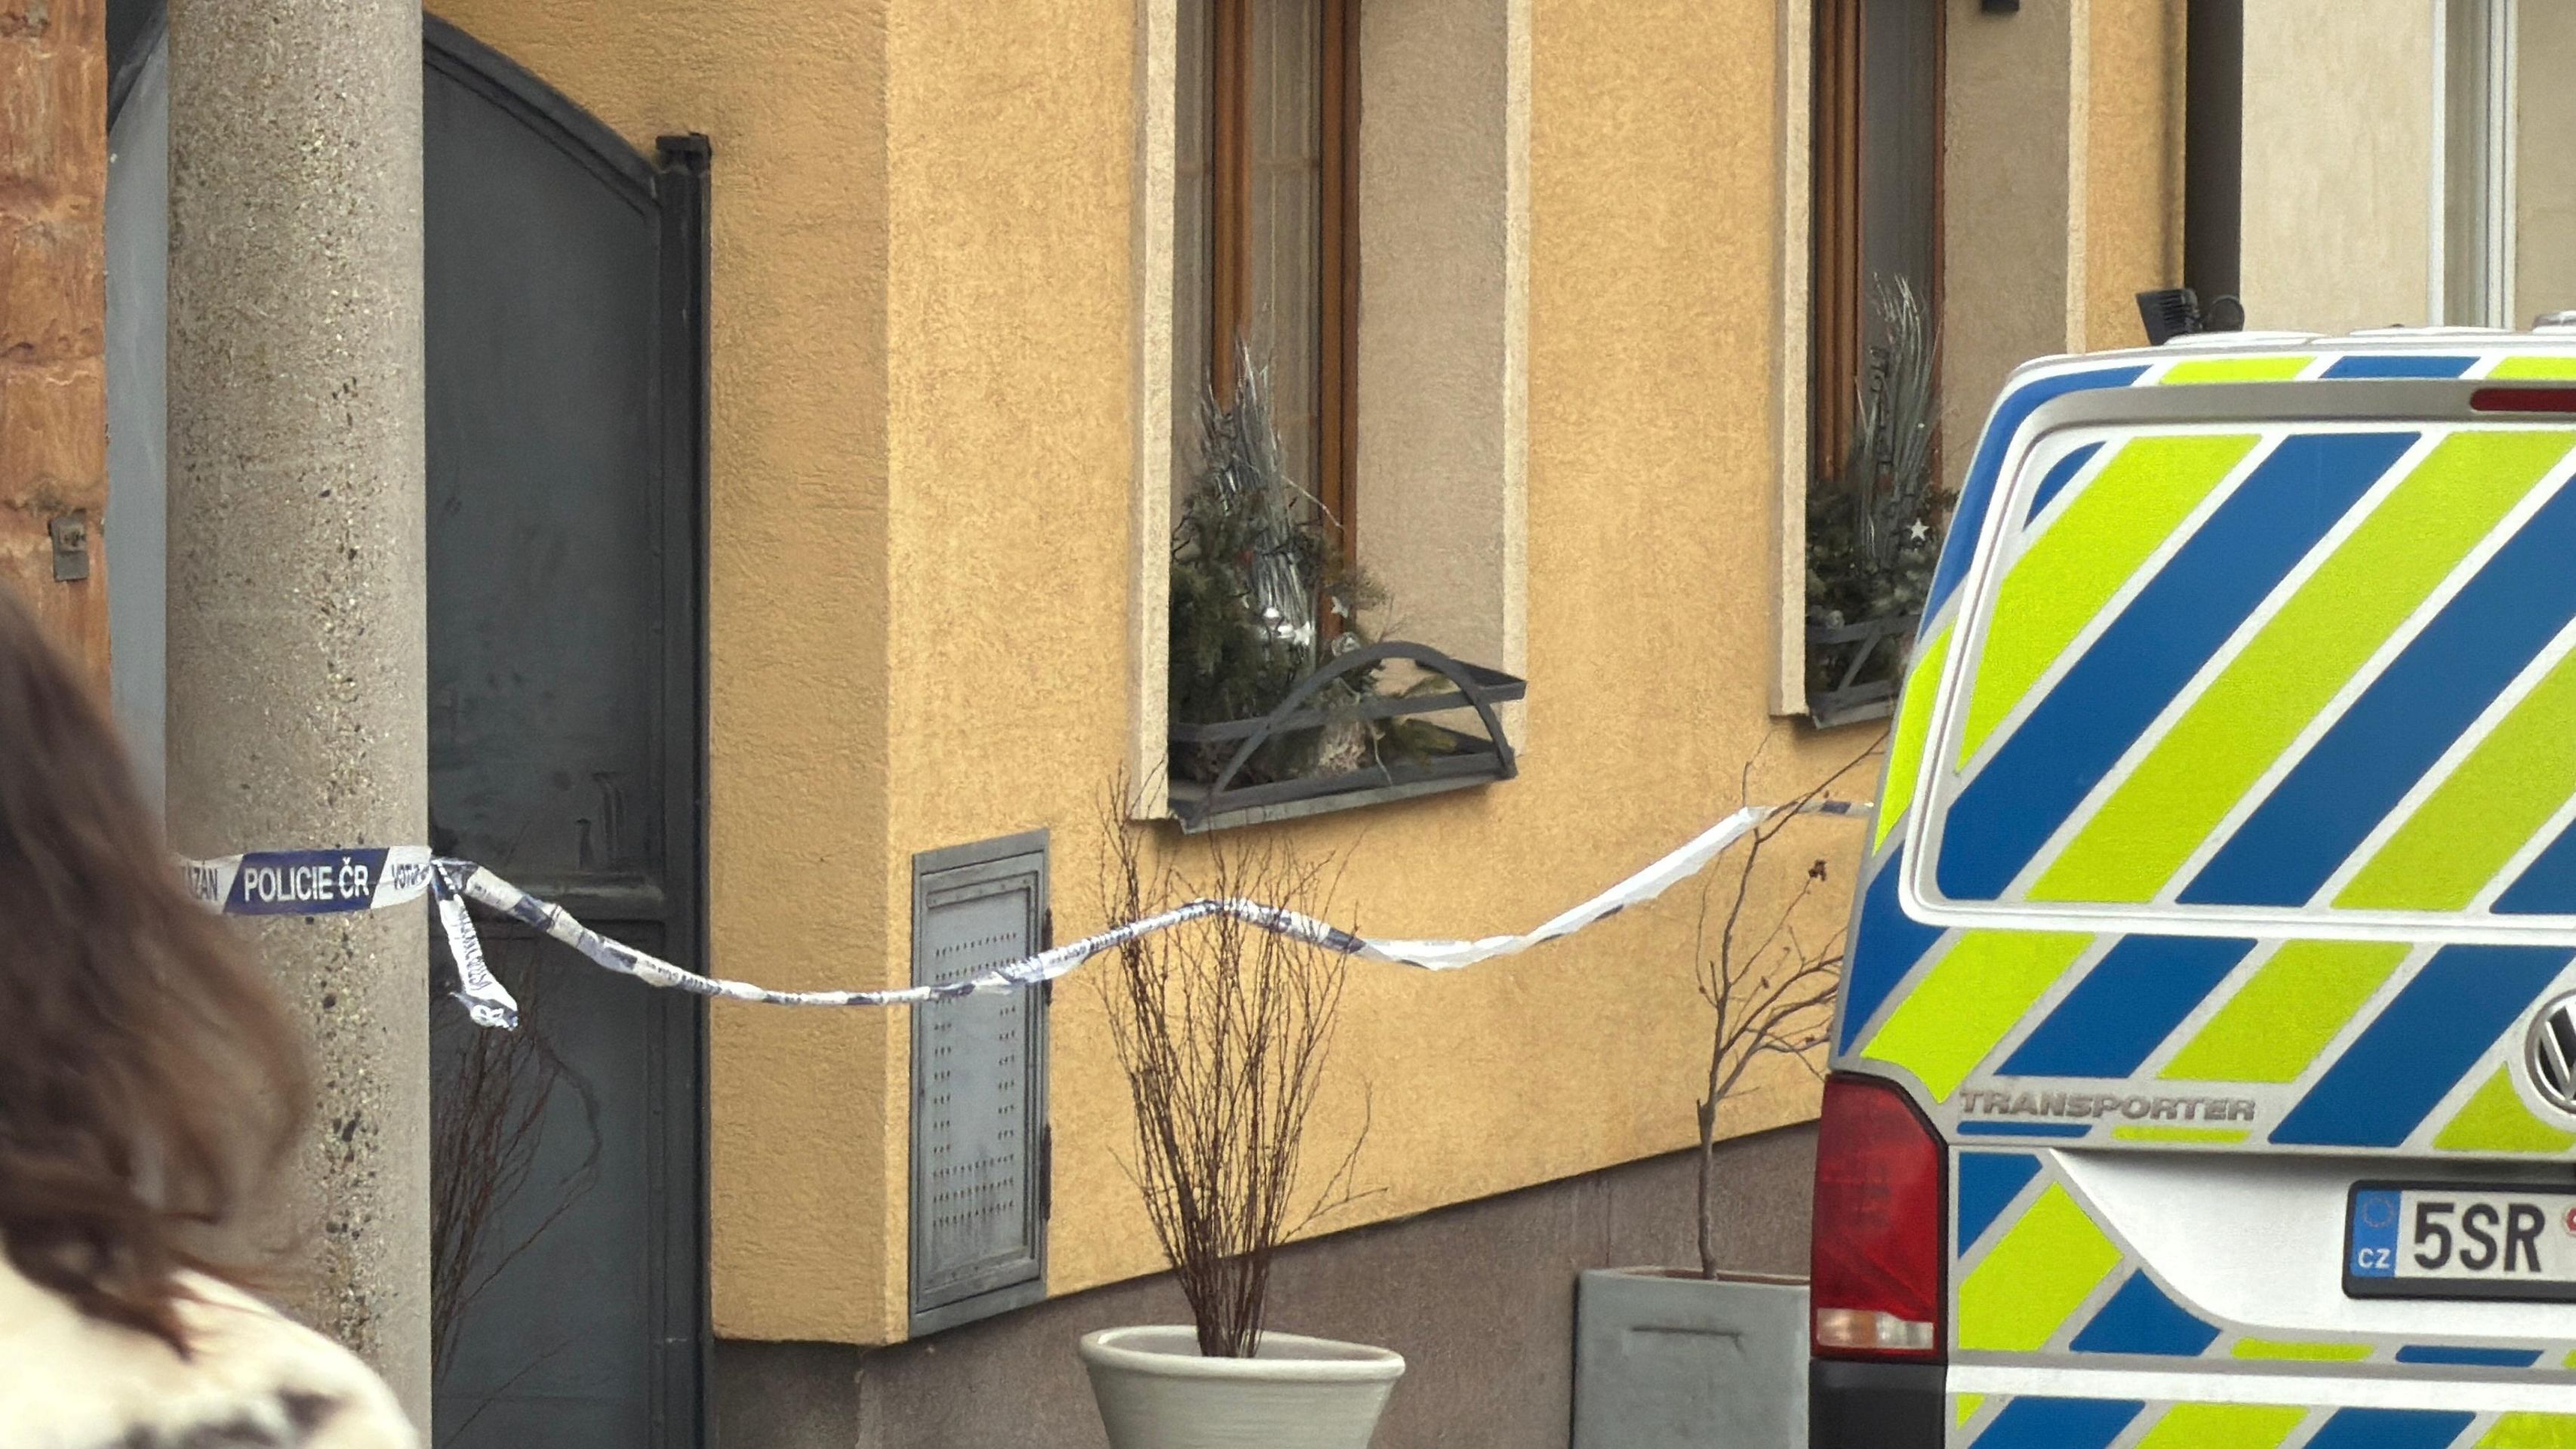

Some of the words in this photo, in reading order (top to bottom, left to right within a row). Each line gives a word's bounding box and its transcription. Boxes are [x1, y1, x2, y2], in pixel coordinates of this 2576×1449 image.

[244, 866, 334, 903] POLICIE
[339, 857, 370, 900] ČR
[1959, 1090, 2256, 1121] TRANSPORTER
[2414, 1201, 2545, 1273] 5SR
[2357, 1247, 2391, 1270] CZ
